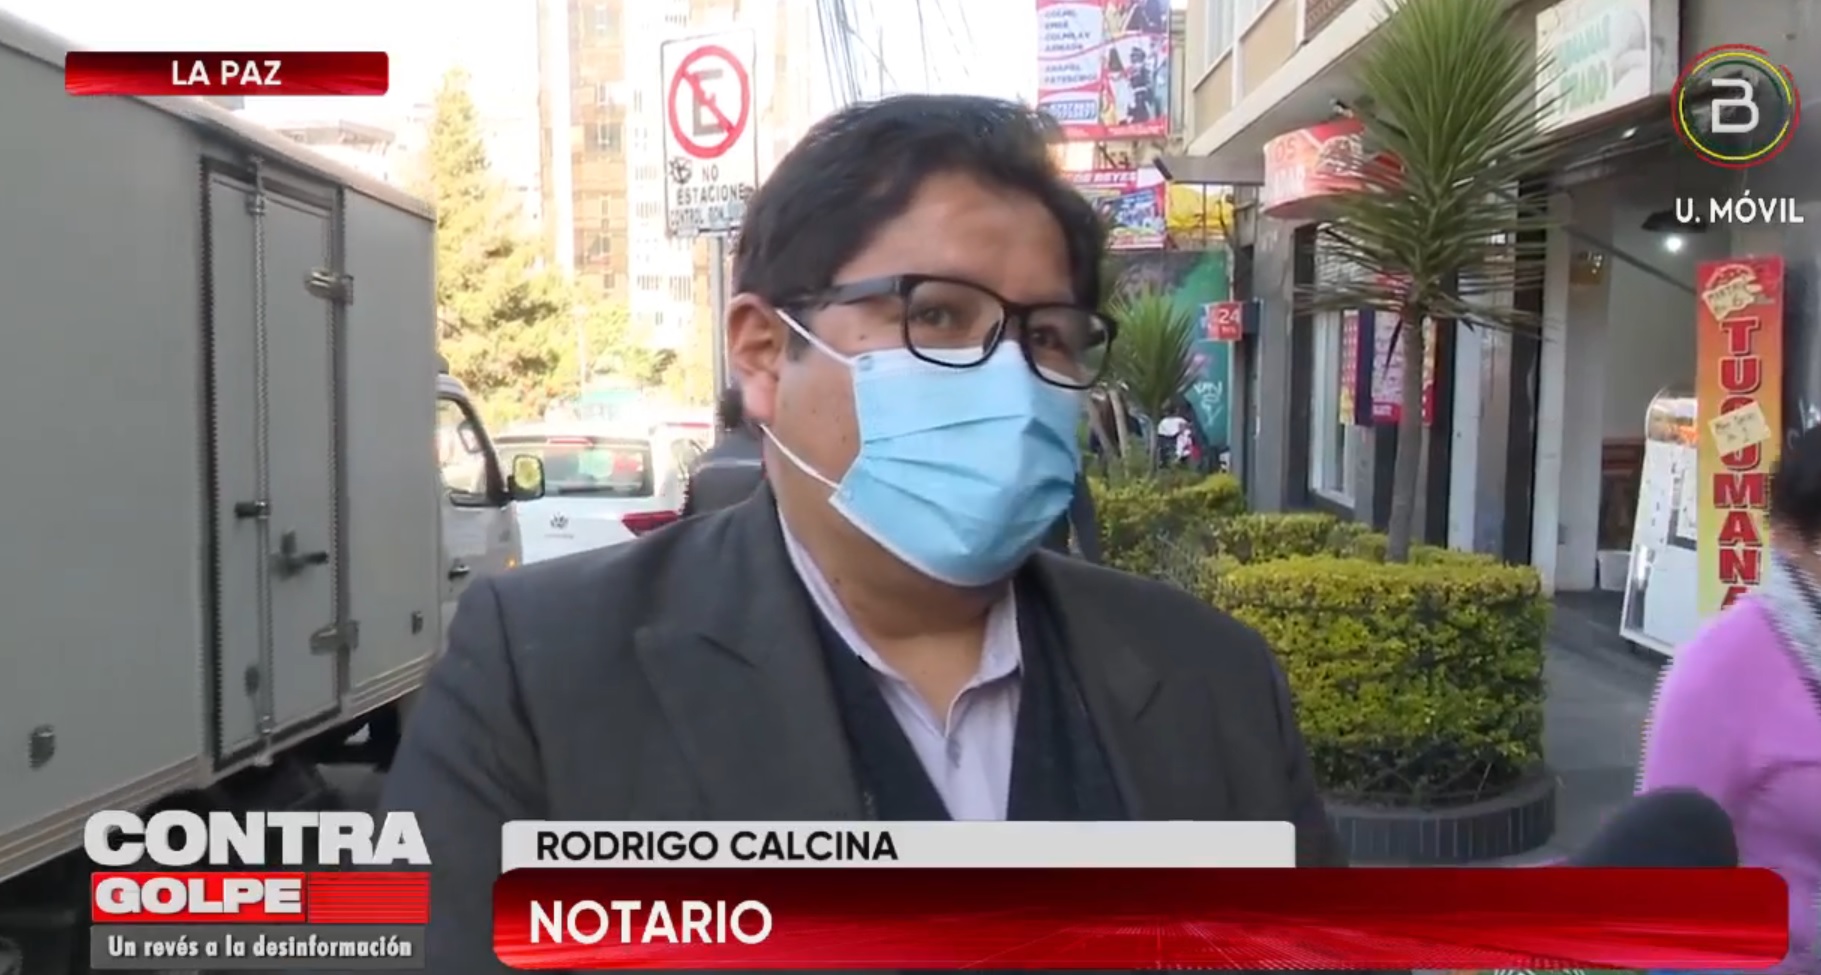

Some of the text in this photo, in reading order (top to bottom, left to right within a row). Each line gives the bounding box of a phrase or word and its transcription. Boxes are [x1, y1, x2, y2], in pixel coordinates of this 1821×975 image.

[702, 164, 719, 182] NO
[676, 183, 745, 206] ESTACIONE
[1219, 308, 1240, 324] 24
